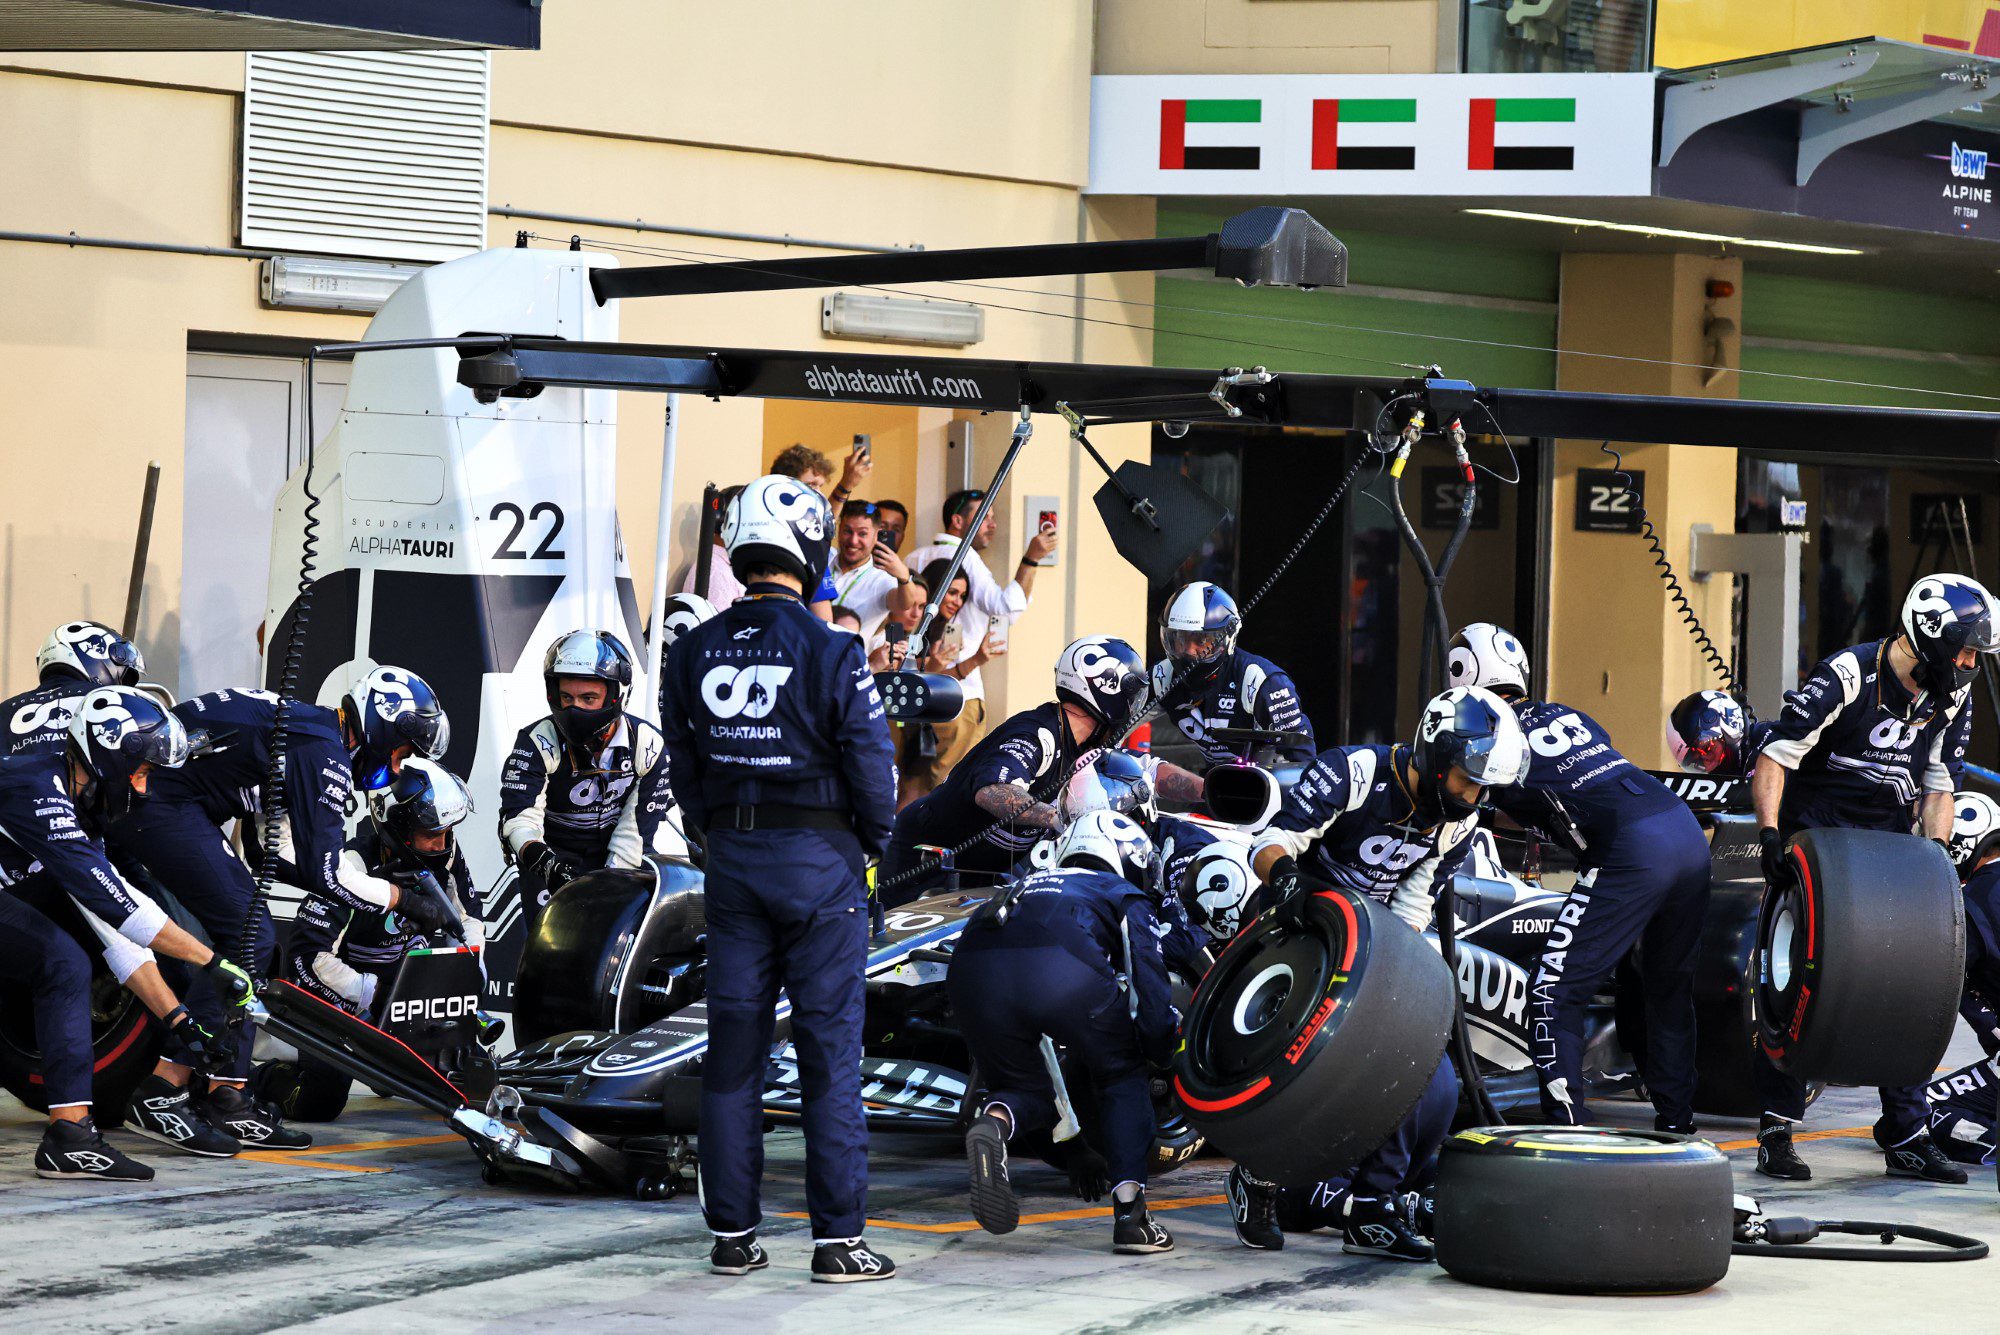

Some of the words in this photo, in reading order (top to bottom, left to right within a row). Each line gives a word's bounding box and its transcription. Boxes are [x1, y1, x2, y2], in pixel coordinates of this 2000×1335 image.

[1942, 184, 1992, 203] ALPINE
[1963, 206, 1979, 219] TEAM
[805, 364, 982, 399] alphataurif1.com
[1590, 485, 1630, 513] 22
[351, 518, 455, 531] SCUDERIA
[489, 501, 566, 560] 22
[350, 536, 455, 559] ALPHATAURI
[705, 650, 783, 659] SCUDERIA
[11, 732, 68, 753] ALPHATAU
[709, 726, 782, 740] ALPHATAURI
[1556, 743, 1611, 774] ALPHATAUR
[1511, 918, 1554, 935] HON
[1456, 946, 1530, 1031] AUR
[1532, 892, 1591, 1071] ALPHATAURI
